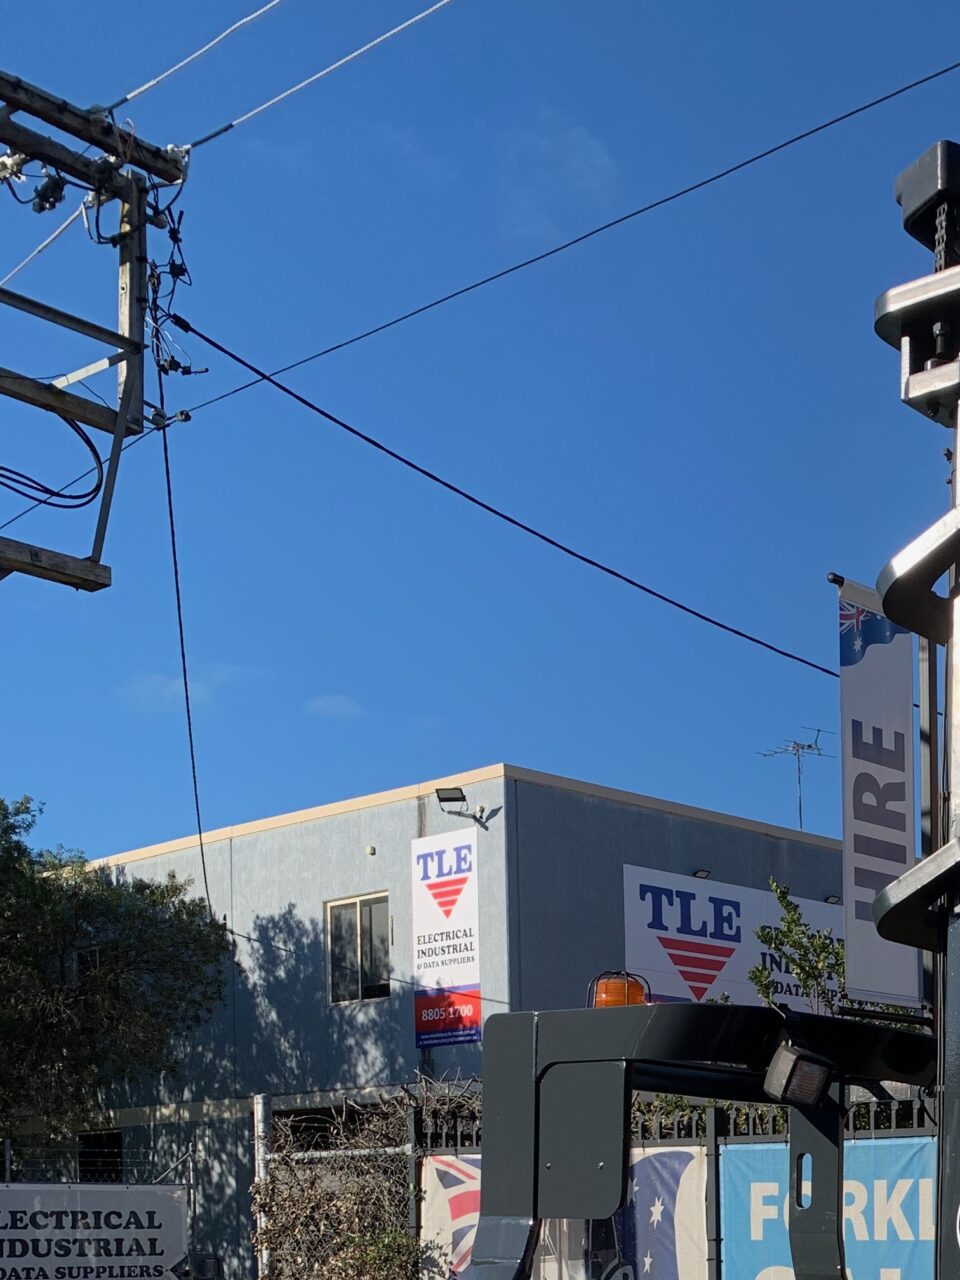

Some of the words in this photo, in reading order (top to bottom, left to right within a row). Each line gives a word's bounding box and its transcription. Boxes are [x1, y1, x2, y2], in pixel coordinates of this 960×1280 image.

[851, 718, 907, 922] HIRE
[416, 844, 472, 881] TLE
[638, 883, 743, 943] TLE
[417, 928, 475, 945] ELECTRICAL
[417, 942, 476, 959] INDUSTRIAL
[423, 960, 440, 969] DATA
[440, 955, 476, 967] SUPPLIERS
[421, 1008, 446, 1021] 8805
[448, 1004, 474, 1018] 1700
[54, 1264, 165, 1280] SUPPLIERS
